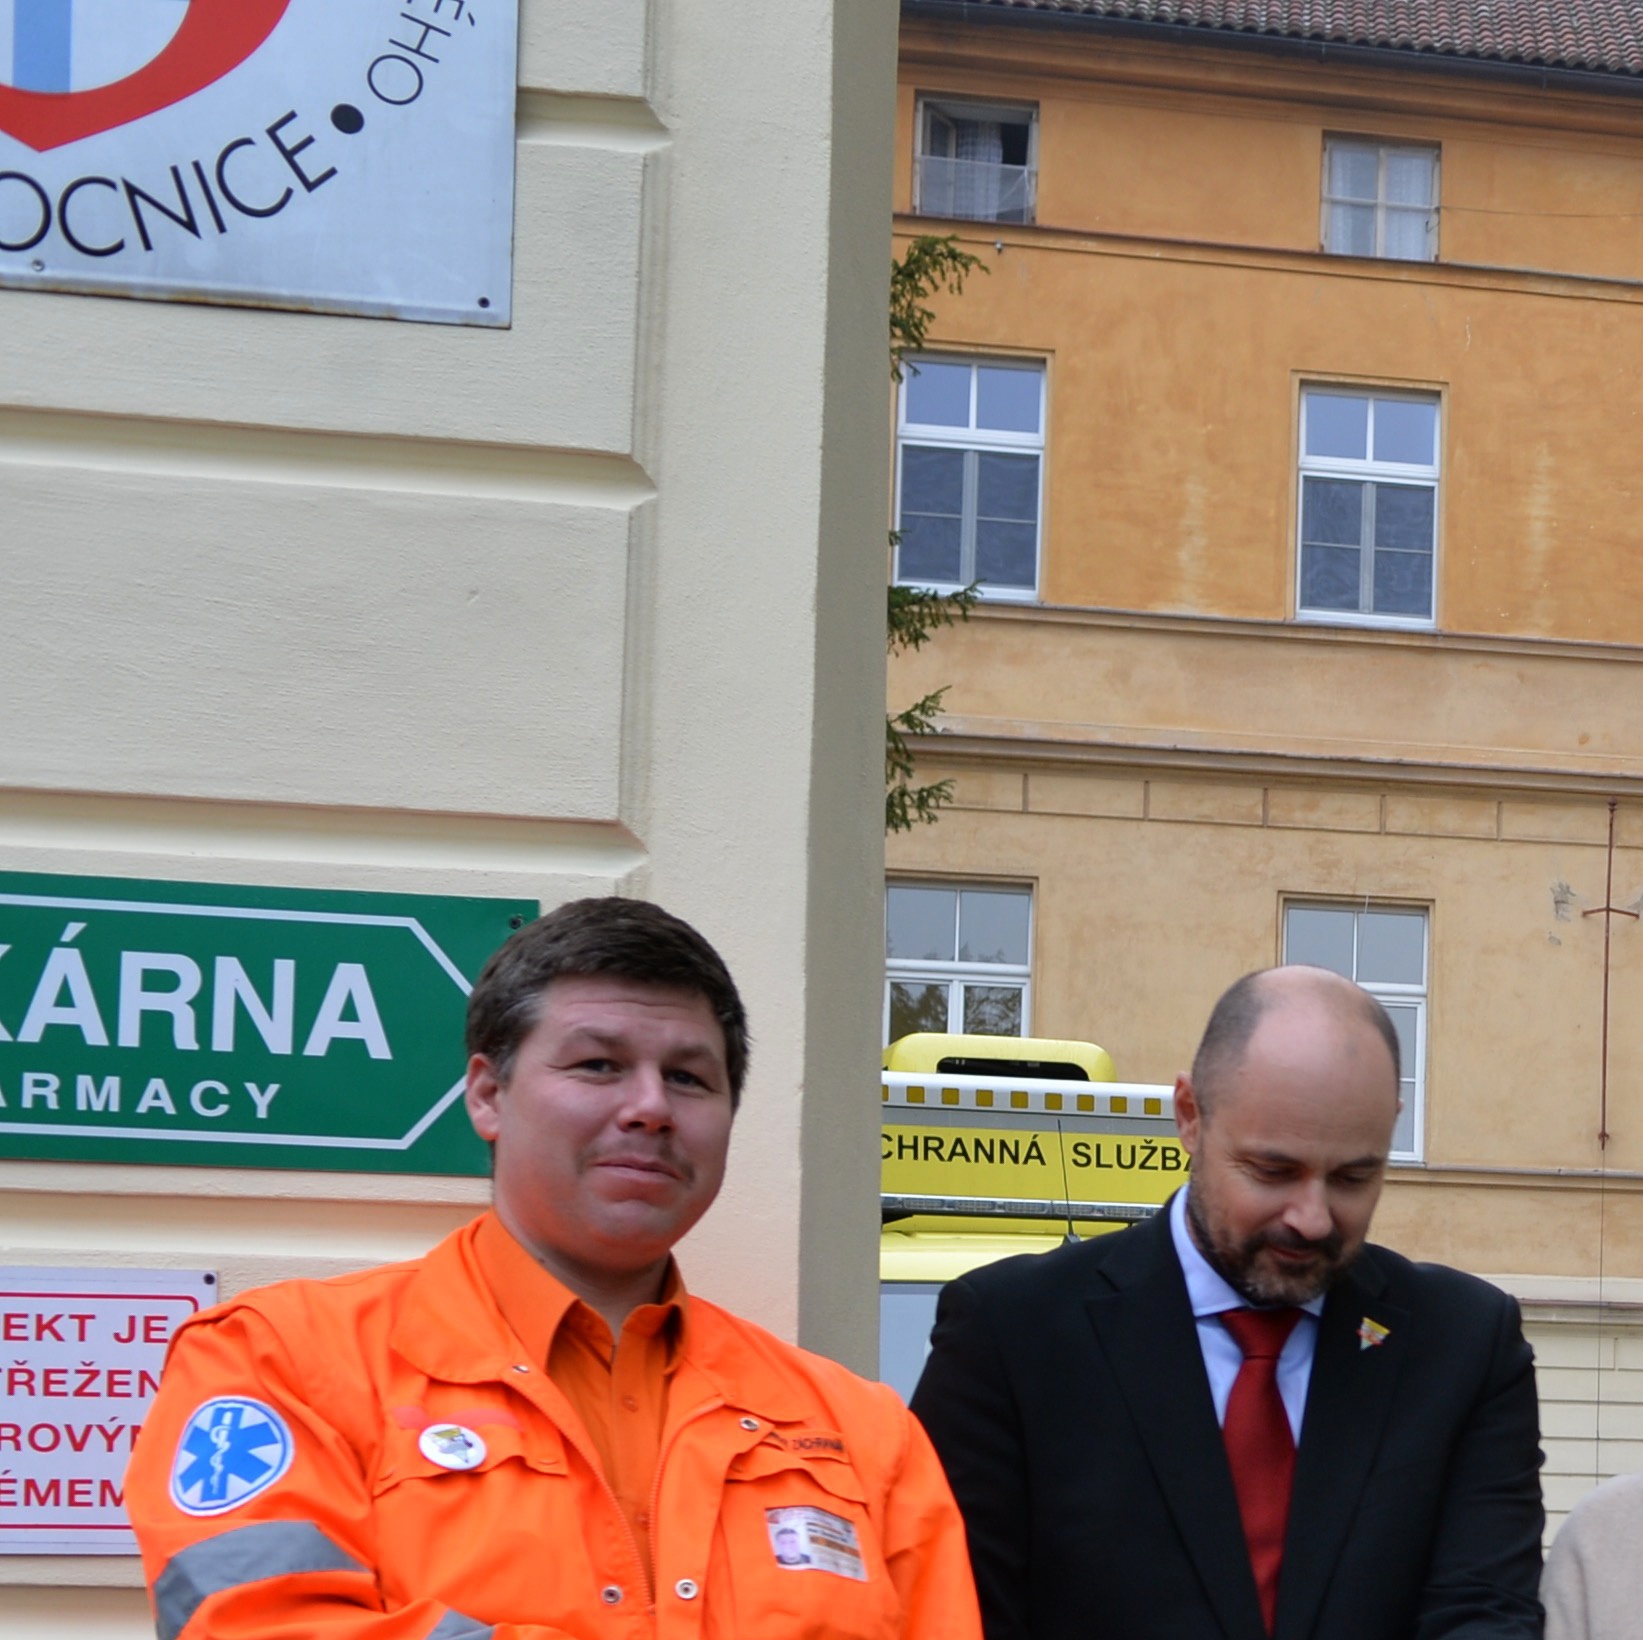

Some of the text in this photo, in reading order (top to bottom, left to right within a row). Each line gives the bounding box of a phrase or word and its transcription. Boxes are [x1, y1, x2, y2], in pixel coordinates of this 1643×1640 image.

[0, 1072, 281, 1119] RMACY
[3, 1313, 168, 1344] EKT JE
[0, 1359, 166, 1398] ŘEŽEN
